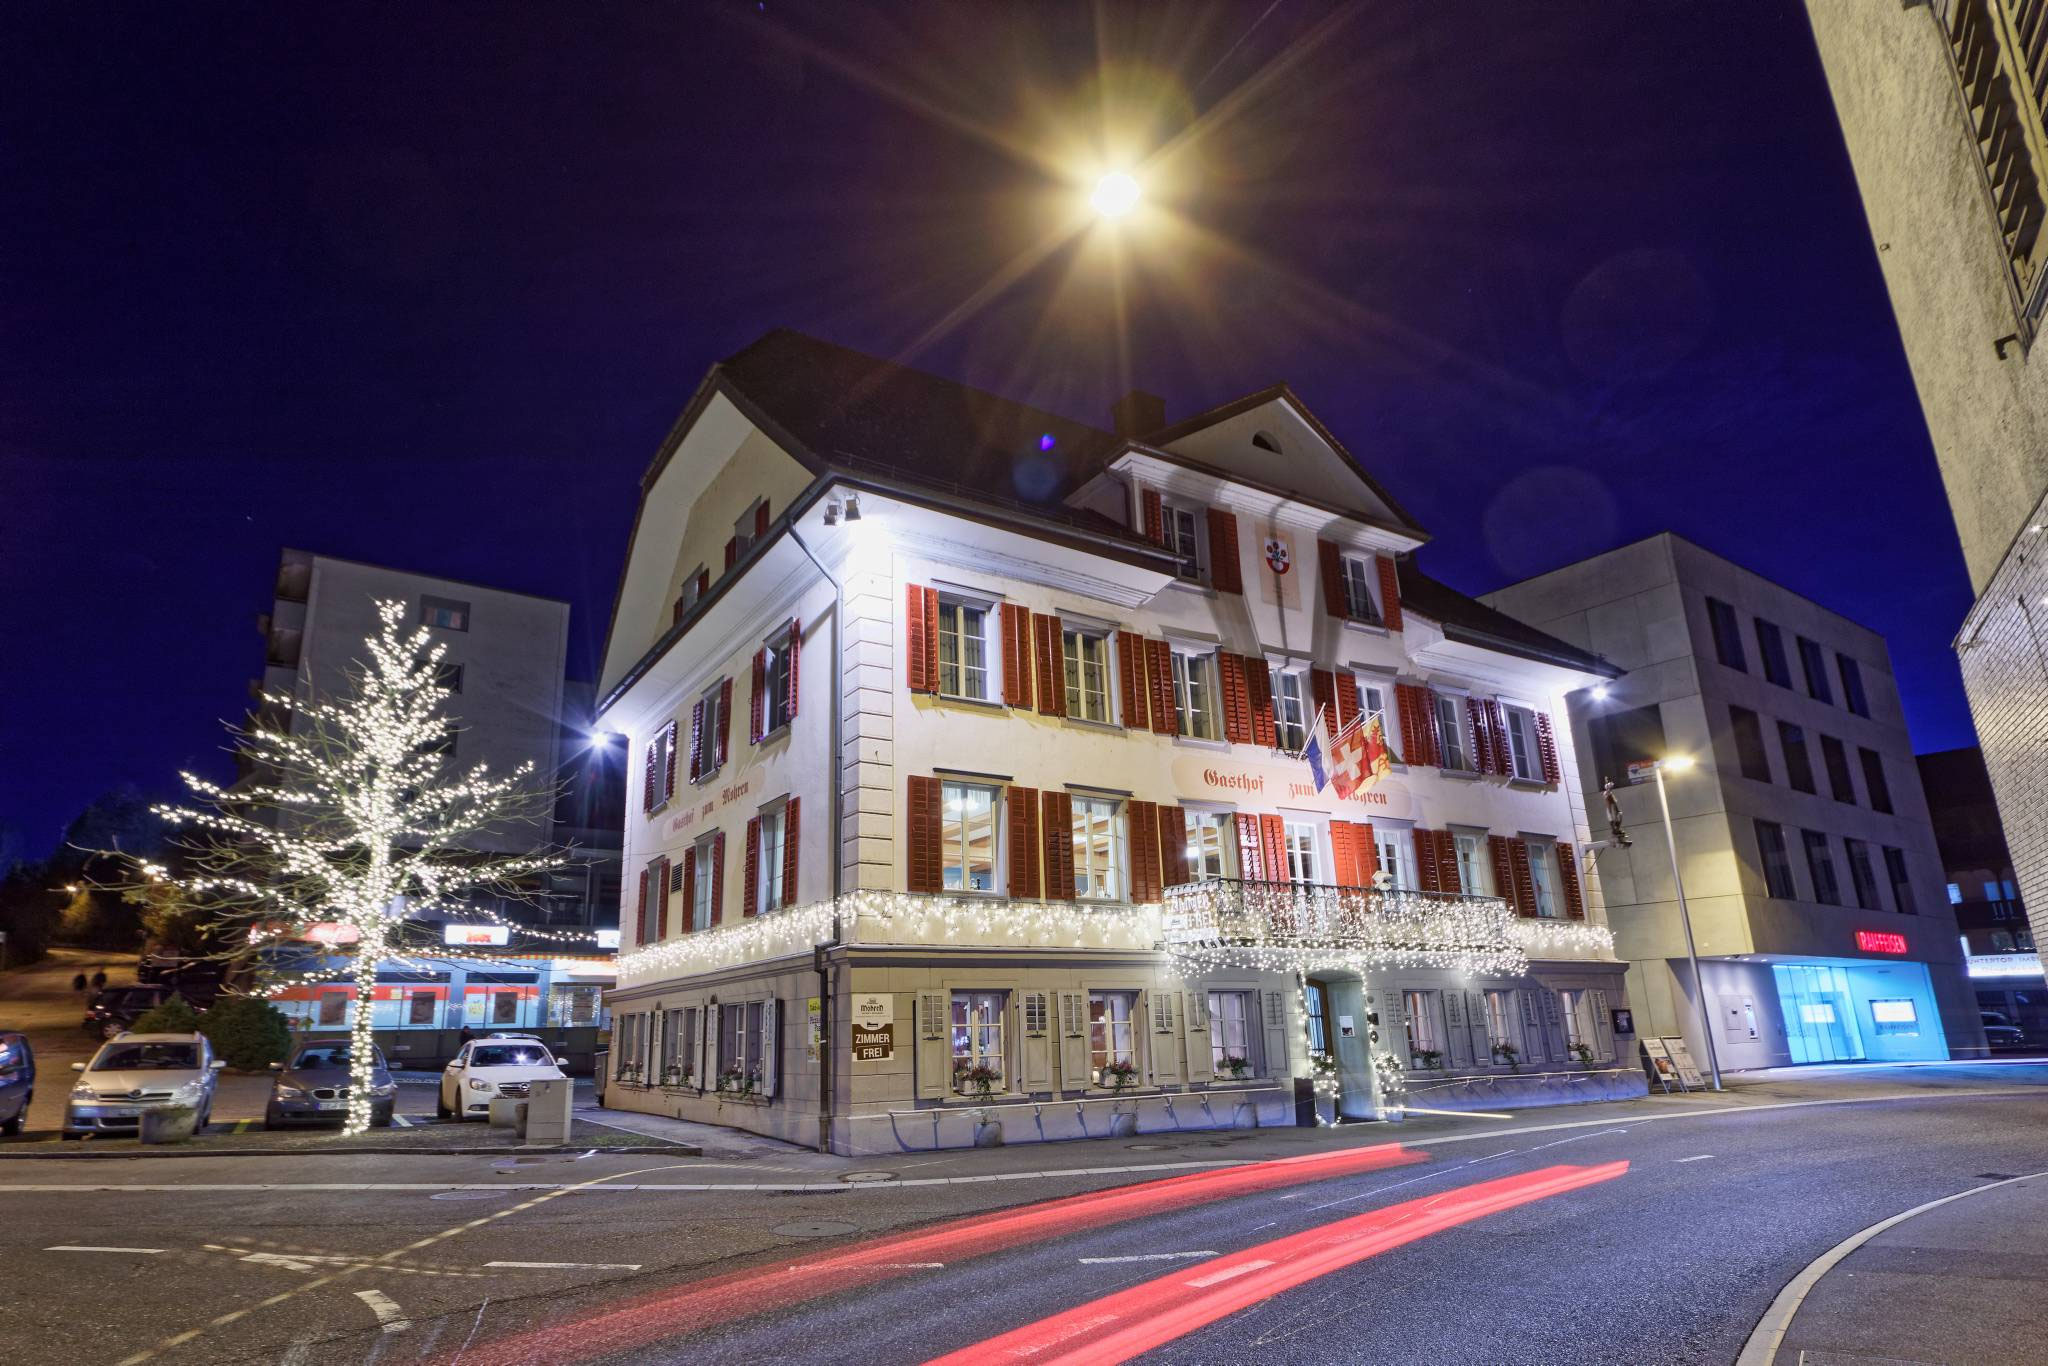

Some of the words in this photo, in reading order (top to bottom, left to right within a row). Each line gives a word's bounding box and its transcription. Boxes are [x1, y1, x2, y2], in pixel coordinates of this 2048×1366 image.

[722, 782, 749, 805] Mohren
[1203, 768, 1264, 793] Gasthof
[1287, 782, 1315, 800] zum
[1859, 930, 1907, 954] RAIFFEISEN
[855, 1033, 890, 1044] ZIMMER
[863, 1047, 883, 1059] FREI
